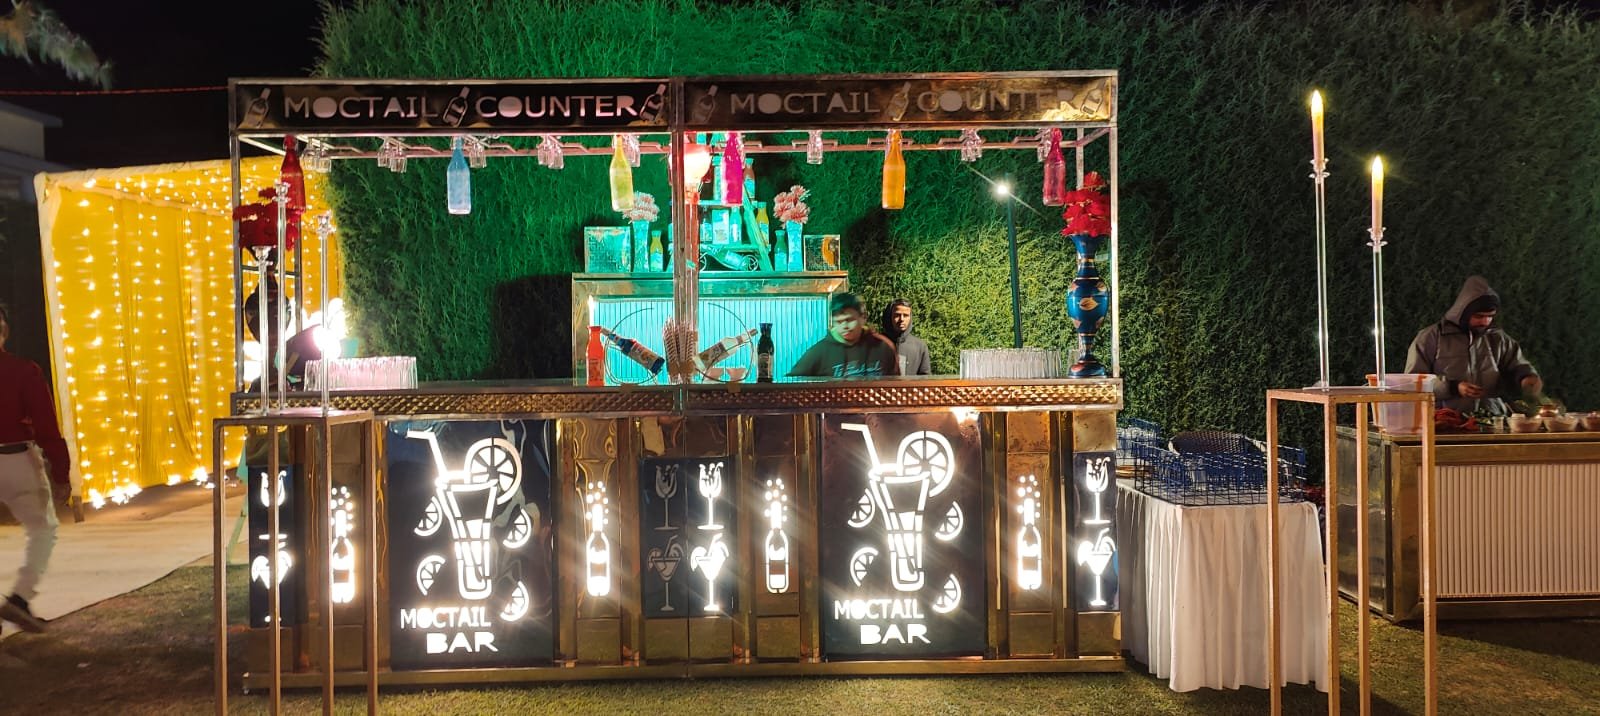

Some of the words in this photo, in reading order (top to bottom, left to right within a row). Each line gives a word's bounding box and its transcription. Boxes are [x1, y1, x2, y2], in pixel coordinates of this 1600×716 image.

[284, 96, 439, 119] MOCTAIL
[475, 95, 638, 118] COUNTER
[730, 92, 881, 114] MOCTAIL
[400, 606, 492, 629] MOCTAIL
[835, 598, 924, 620] MOCTAIL
[426, 631, 499, 654] BAR
[860, 623, 931, 645] BAR
